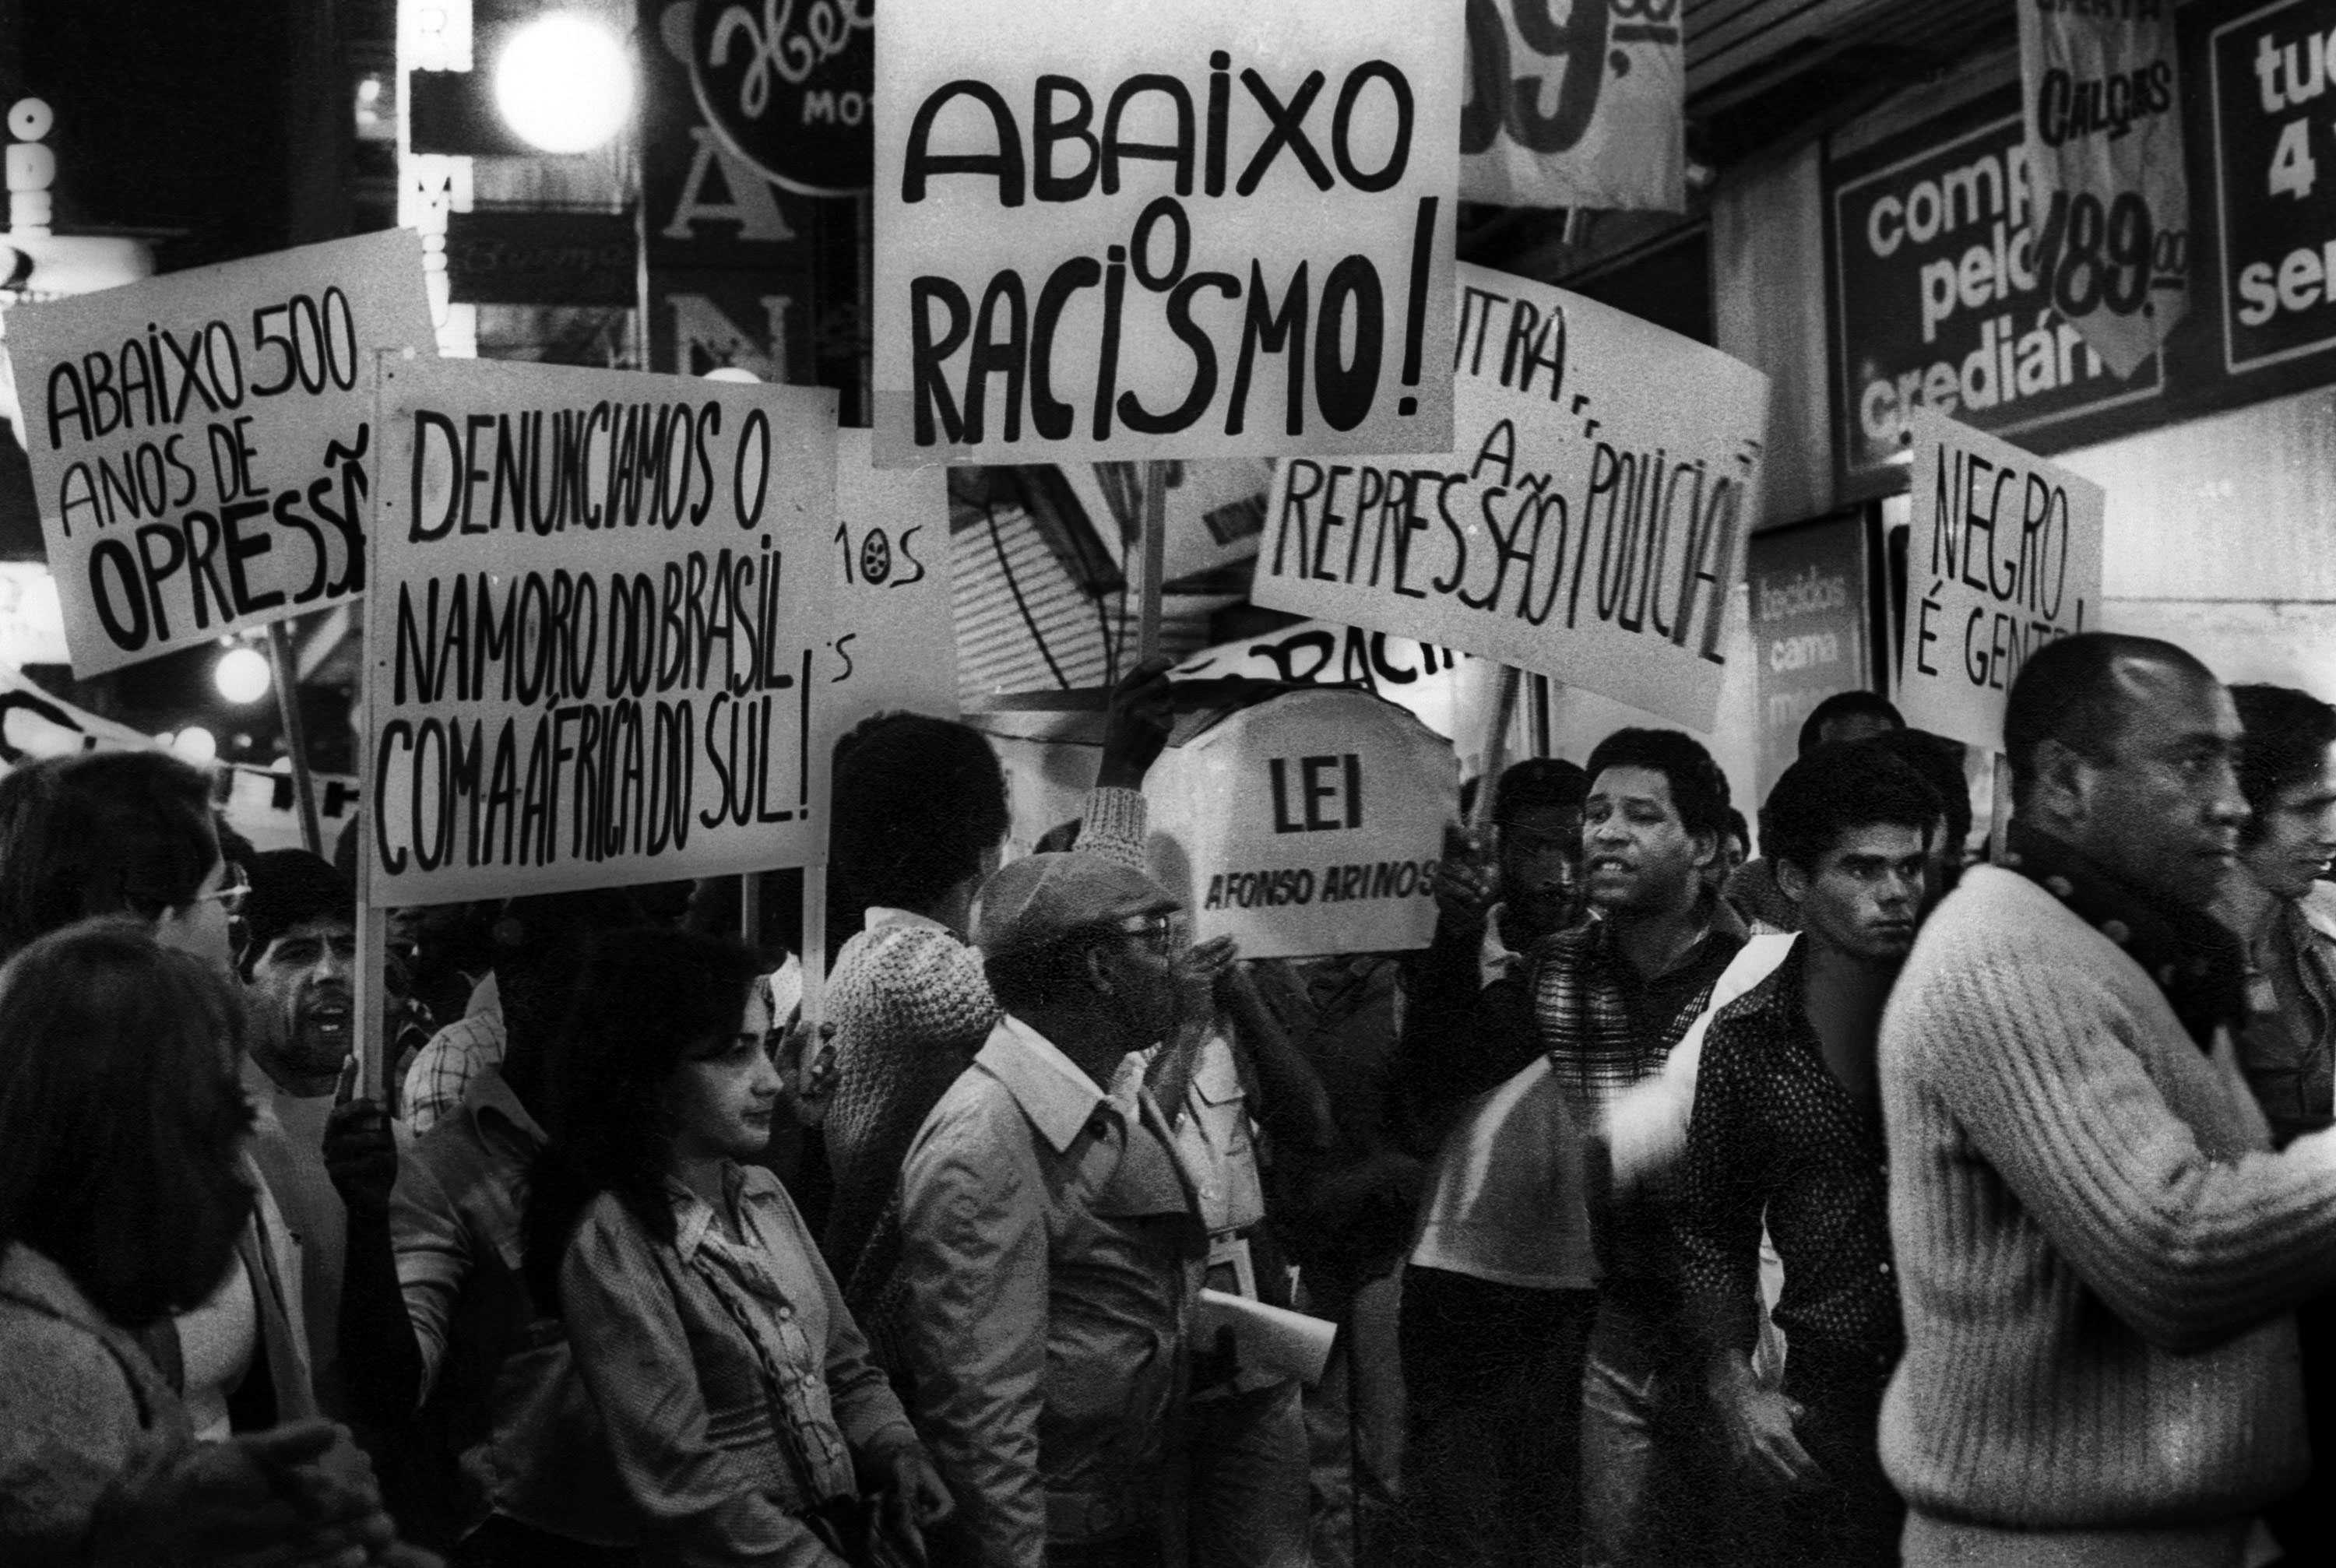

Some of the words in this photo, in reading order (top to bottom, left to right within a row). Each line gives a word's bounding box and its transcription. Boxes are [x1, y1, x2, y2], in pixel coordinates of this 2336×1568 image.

[803, 90, 874, 125] MO
[902, 48, 1415, 206] ABAIXO
[2254, 30, 2336, 114] tu
[1130, 195, 1191, 292] O
[2238, 237, 2336, 327] se
[47, 321, 244, 450] ABAIXO
[251, 286, 357, 396] 500
[909, 195, 1439, 446] RACISMO!
[59, 433, 197, 537] ANOS
[207, 414, 270, 505] DE
[409, 400, 721, 543] DENUNCIAMOS
[734, 408, 770, 529] O
[1473, 418, 1515, 487] A
[1272, 459, 1568, 626] REPRESSÃO
[1932, 441, 2068, 621] NEGRO
[394, 568, 597, 706] NAMORO
[607, 572, 656, 699] DO
[656, 534, 793, 697] BRASIL
[1770, 631, 1838, 673] cama
[1916, 580, 1941, 677] É
[374, 715, 484, 875] COM
[1270, 754, 1361, 834] LEI
[1205, 868, 1316, 911] AFONSO
[1322, 859, 1441, 903] ARINOS
